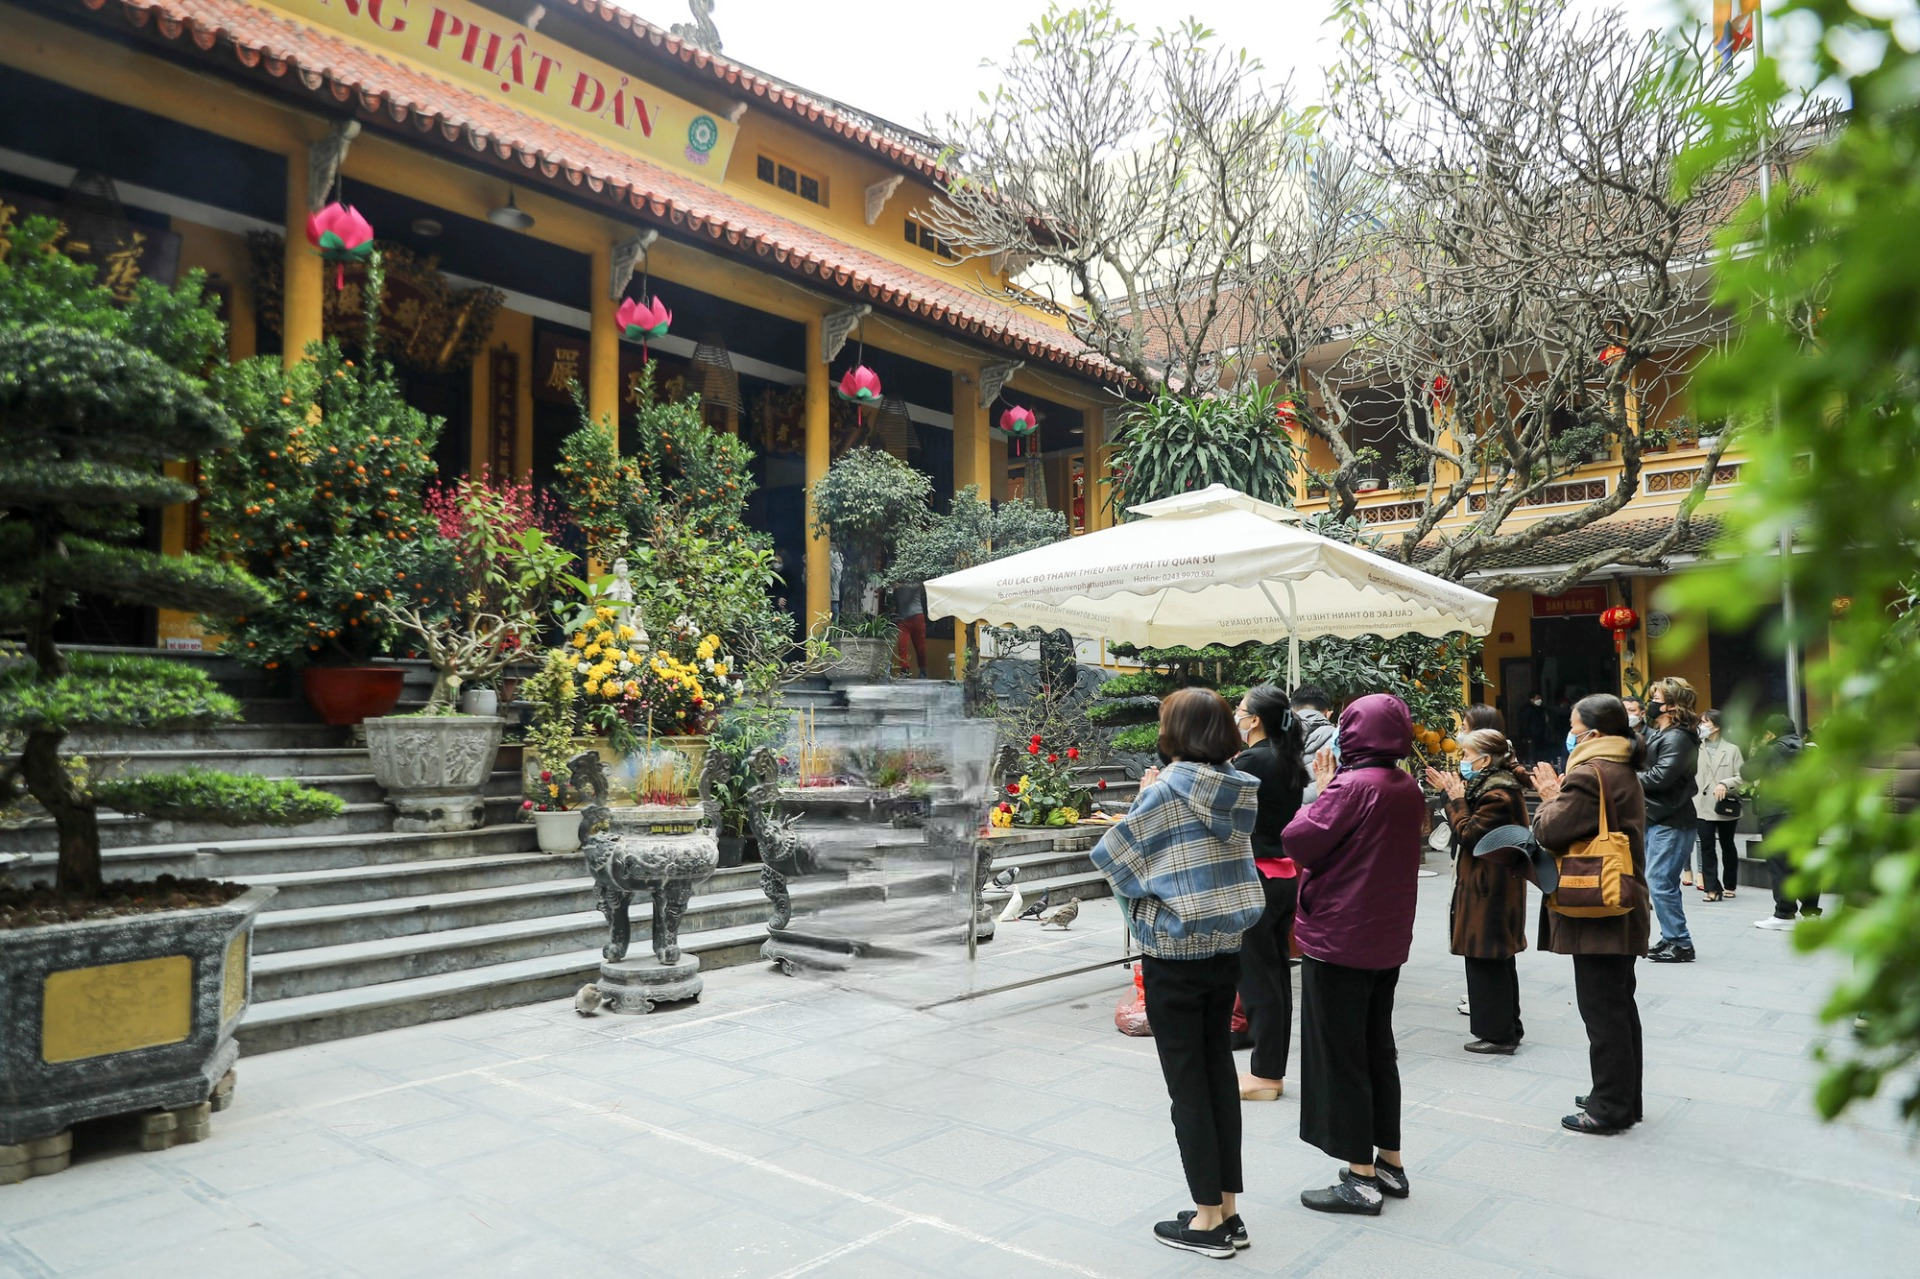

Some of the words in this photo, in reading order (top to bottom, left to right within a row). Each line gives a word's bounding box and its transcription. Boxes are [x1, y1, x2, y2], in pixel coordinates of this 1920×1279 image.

[424, 7, 563, 95] PHẬT
[569, 71, 662, 139] ĐẢN
[1046, 570, 1077, 581] THANH
[1133, 574, 1161, 583] Hotline:
[1162, 570, 1215, 581] 0243.9970.982
